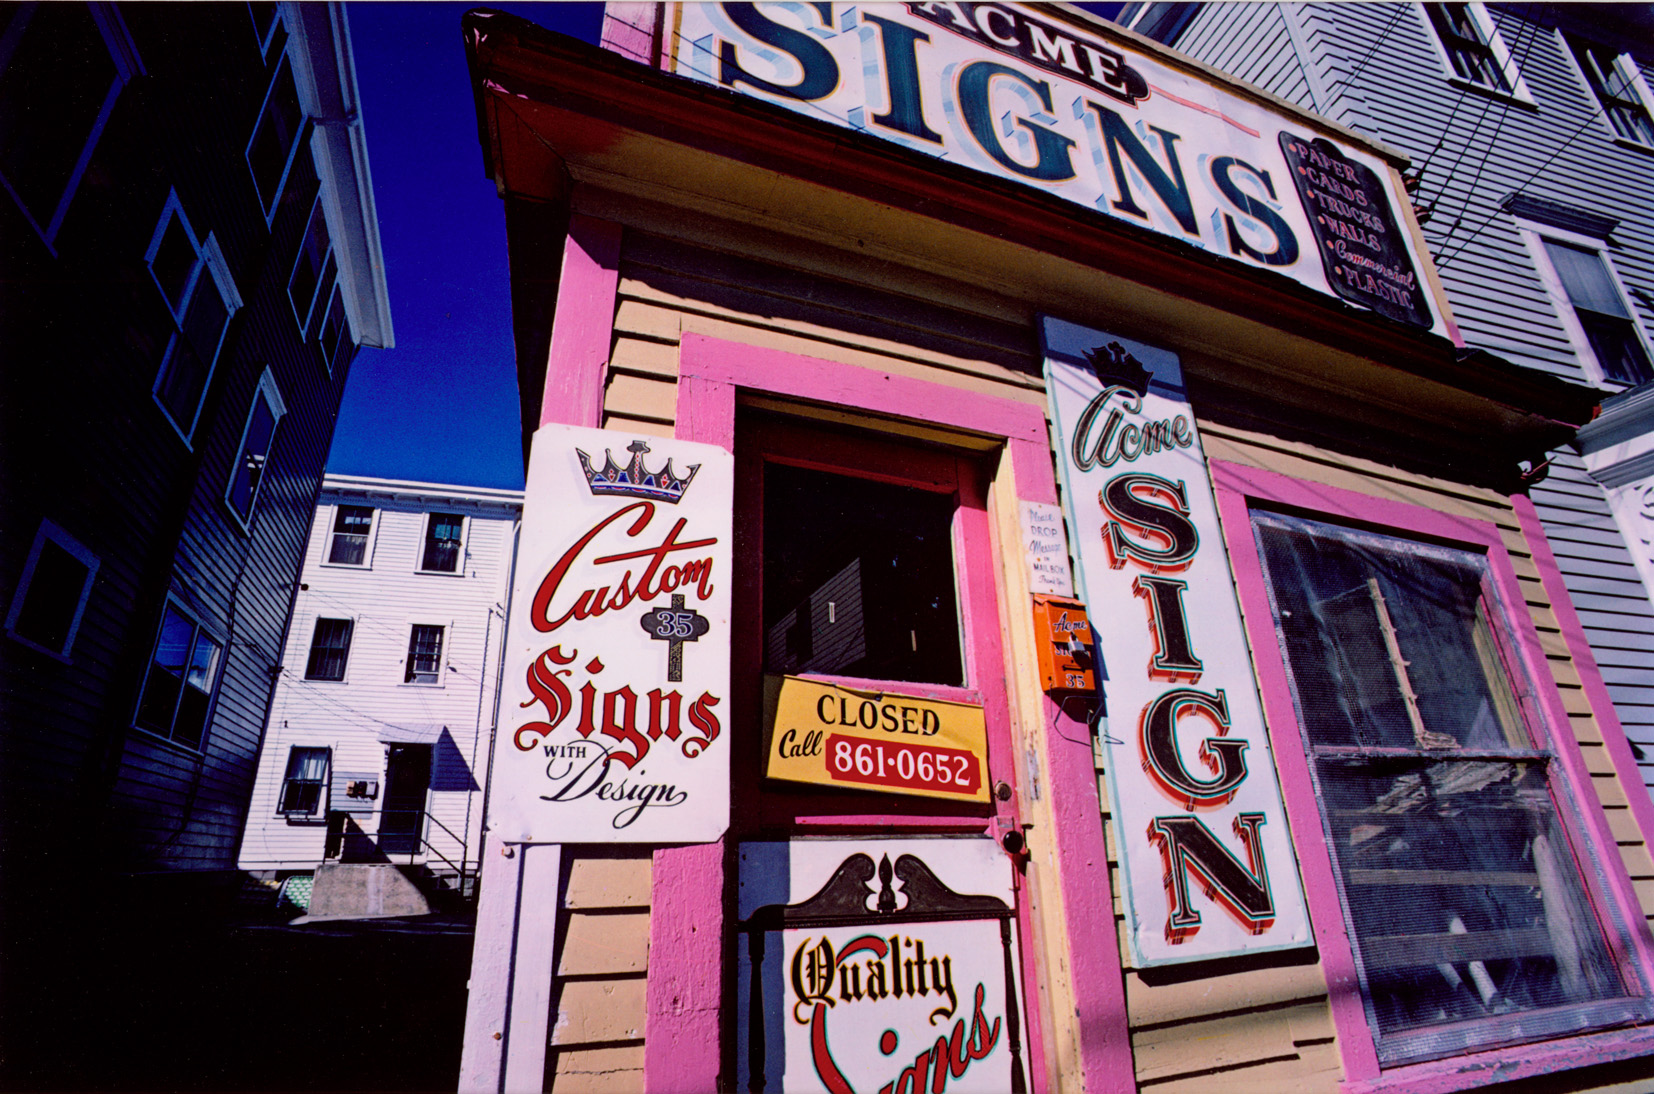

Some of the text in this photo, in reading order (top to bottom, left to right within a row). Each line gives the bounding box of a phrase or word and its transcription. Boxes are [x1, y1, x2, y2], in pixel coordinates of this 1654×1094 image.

[716, 2, 1301, 267] SIGNS
[1295, 142, 1360, 184] PAPER
[1306, 167, 1368, 206] CARDS
[1313, 189, 1385, 233] TRUCKS
[1323, 213, 1381, 252] WALLS
[1334, 239, 1416, 291] Commercial
[1343, 264, 1415, 310] PLASTIC
[1072, 385, 1193, 471] Acme
[1031, 525, 1058, 537] DROP
[530, 501, 718, 633] Custom
[657, 611, 694, 637] 35
[1053, 611, 1088, 632] Acme
[1065, 673, 1086, 689] 35
[514, 645, 720, 770] Signs
[816, 694, 940, 737] CLOSED
[1098, 471, 1276, 946] SIGN
[543, 744, 587, 760] WITH
[779, 729, 823, 759] Call
[539, 739, 688, 829] Design
[790, 934, 958, 1027] Quality
